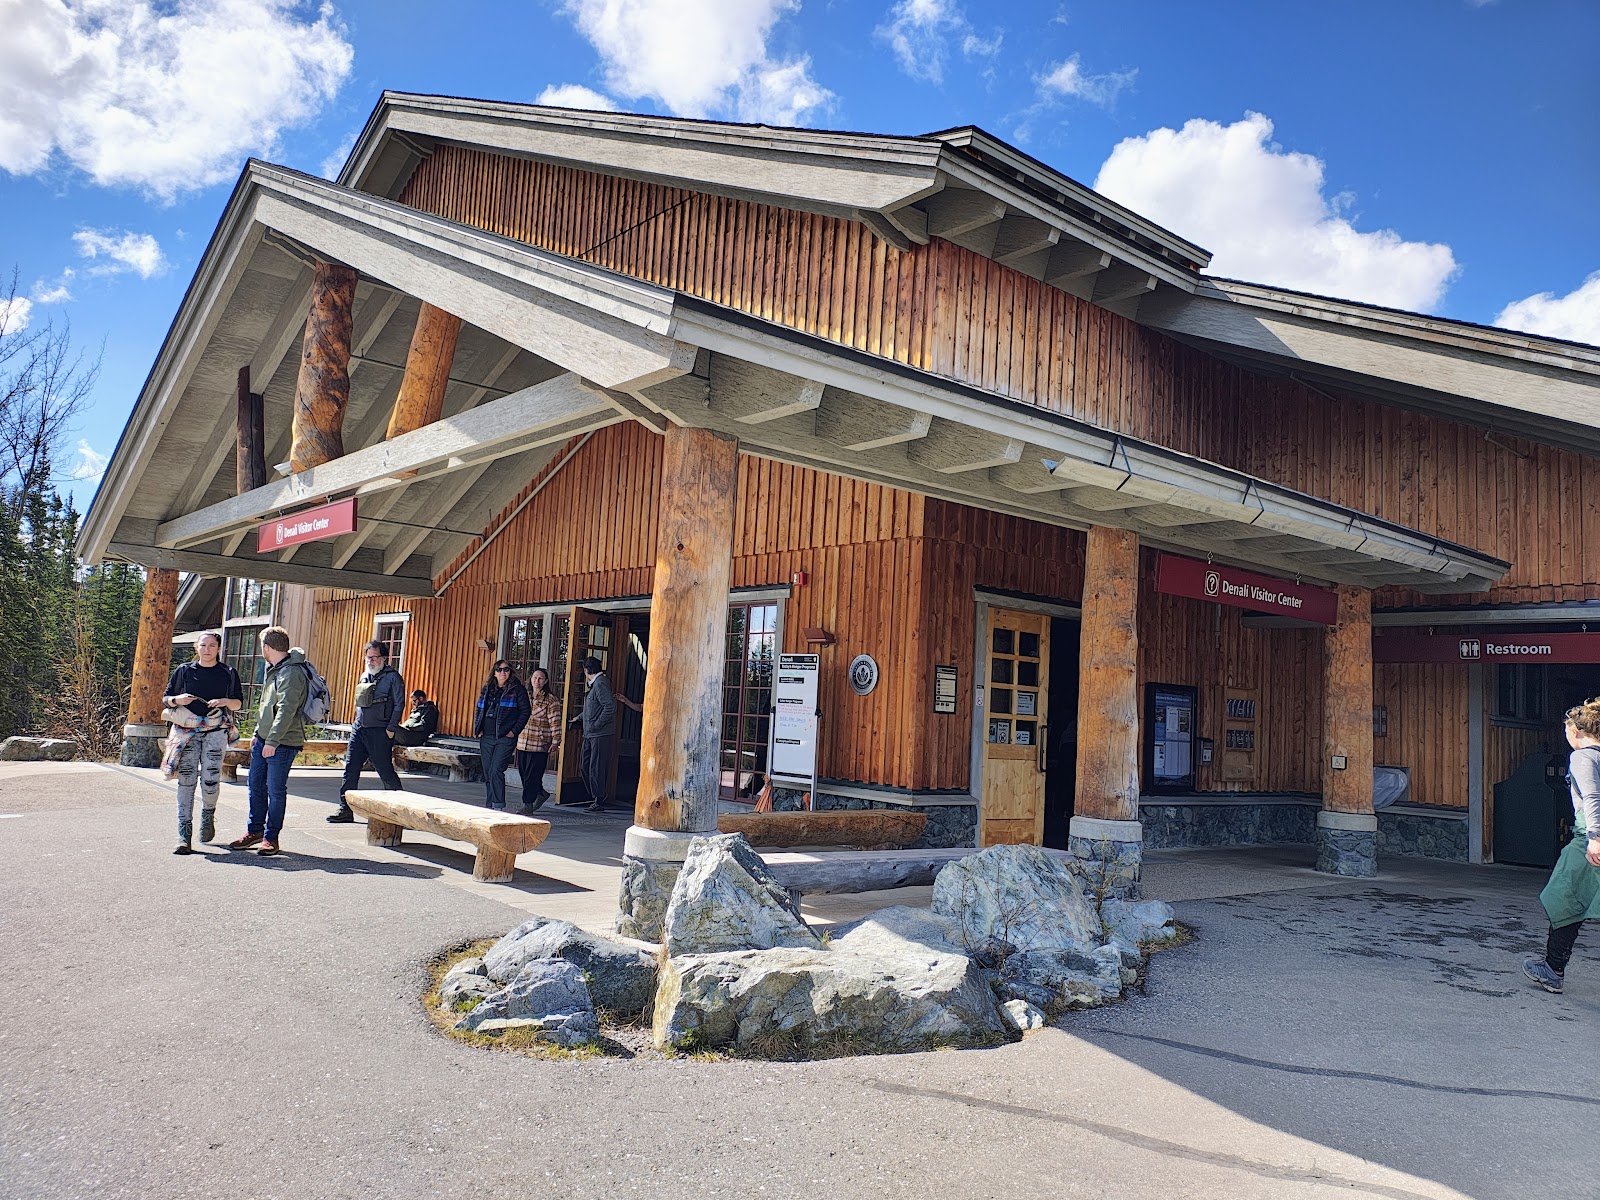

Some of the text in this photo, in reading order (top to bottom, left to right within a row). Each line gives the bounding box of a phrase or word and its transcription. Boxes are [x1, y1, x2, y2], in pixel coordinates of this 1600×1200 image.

[284, 518, 329, 538] Denali Visitor Center
[1222, 580, 1302, 609] Denali Visitor Center
[1486, 643, 1552, 655] Restroom
